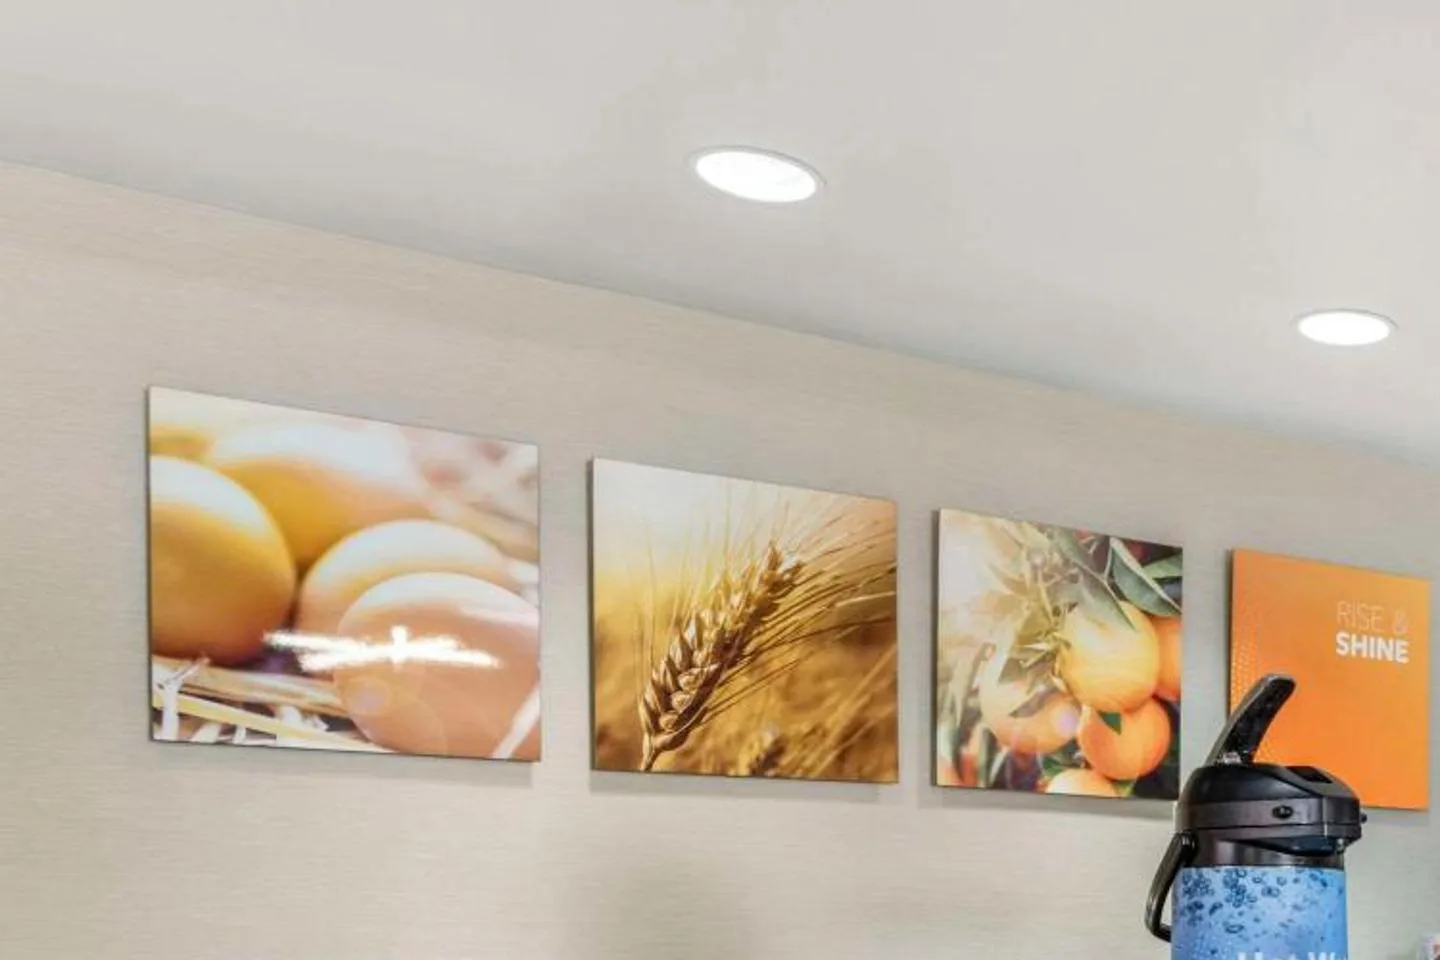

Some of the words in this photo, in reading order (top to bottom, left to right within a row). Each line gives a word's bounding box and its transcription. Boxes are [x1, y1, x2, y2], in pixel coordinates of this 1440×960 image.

[1337, 600, 1384, 633] RISE
[1392, 609, 1409, 634] &
[1336, 631, 1410, 664] SHINE
